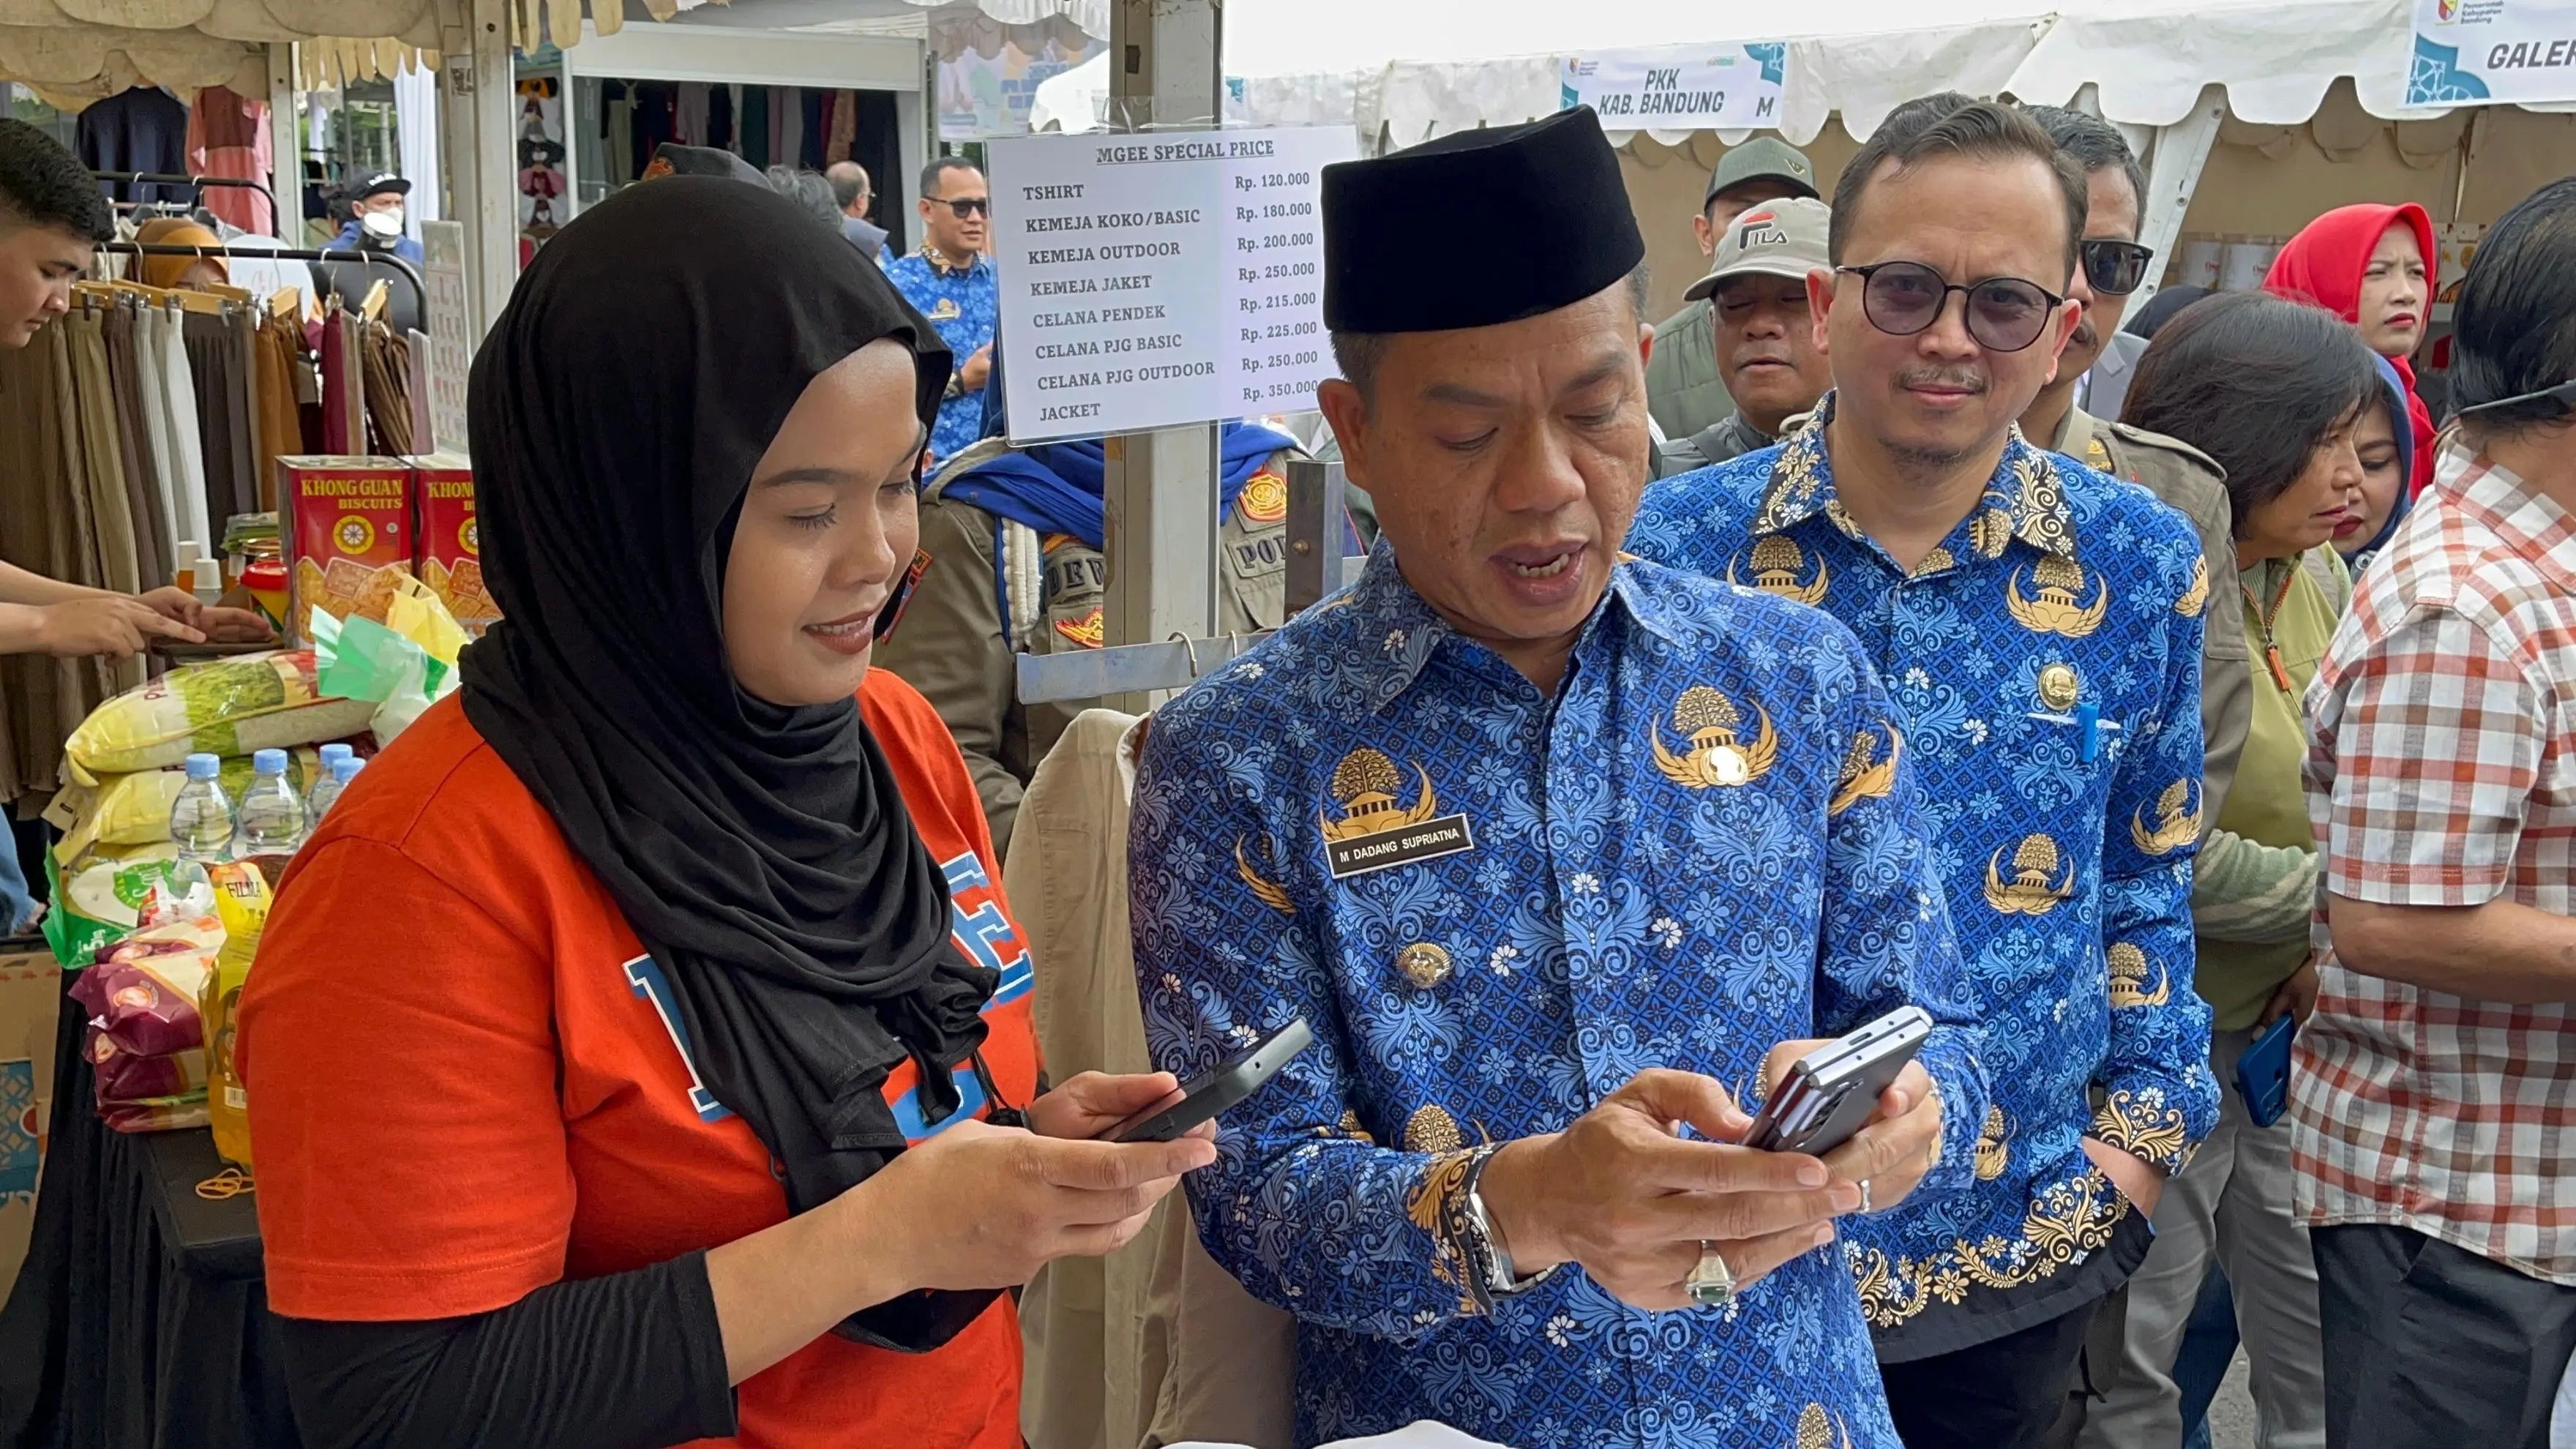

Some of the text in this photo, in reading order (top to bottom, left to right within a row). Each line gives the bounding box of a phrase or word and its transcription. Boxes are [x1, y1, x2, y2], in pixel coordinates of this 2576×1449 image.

[1644, 69, 1680, 91] PKK
[1598, 91, 1725, 116] KAB. BANDUNG
[1756, 97, 1775, 117] M
[1096, 140, 1274, 162] MGEE SPECIAL PRICE
[1022, 172, 1310, 201] TSHIRT Rp. 120.000
[1025, 202, 1312, 233] KEMEJA KOKO/BASIC Rp. 180.000
[1739, 211, 1789, 250] FILA
[1027, 232, 1314, 265] KEMEJA OUTDOOR Rp. 200.000
[1030, 262, 1315, 296] KEMEJA JAKET Rp. 250.000
[1033, 292, 1316, 328] CELANA PENDEK Rp. 215.000
[1035, 321, 1317, 359] CELANA PJG BASIC Rp. 225.000
[1037, 351, 1318, 391] CELANA PJG OUTDOOR Rp. 250.000
[1039, 380, 1318, 422] JACKET Rp. 350.000
[301, 479, 402, 496] KHONG GUAN
[338, 498, 403, 509] BISCUITS
[1339, 828, 1460, 863] M DADANG SUPRIATNA
